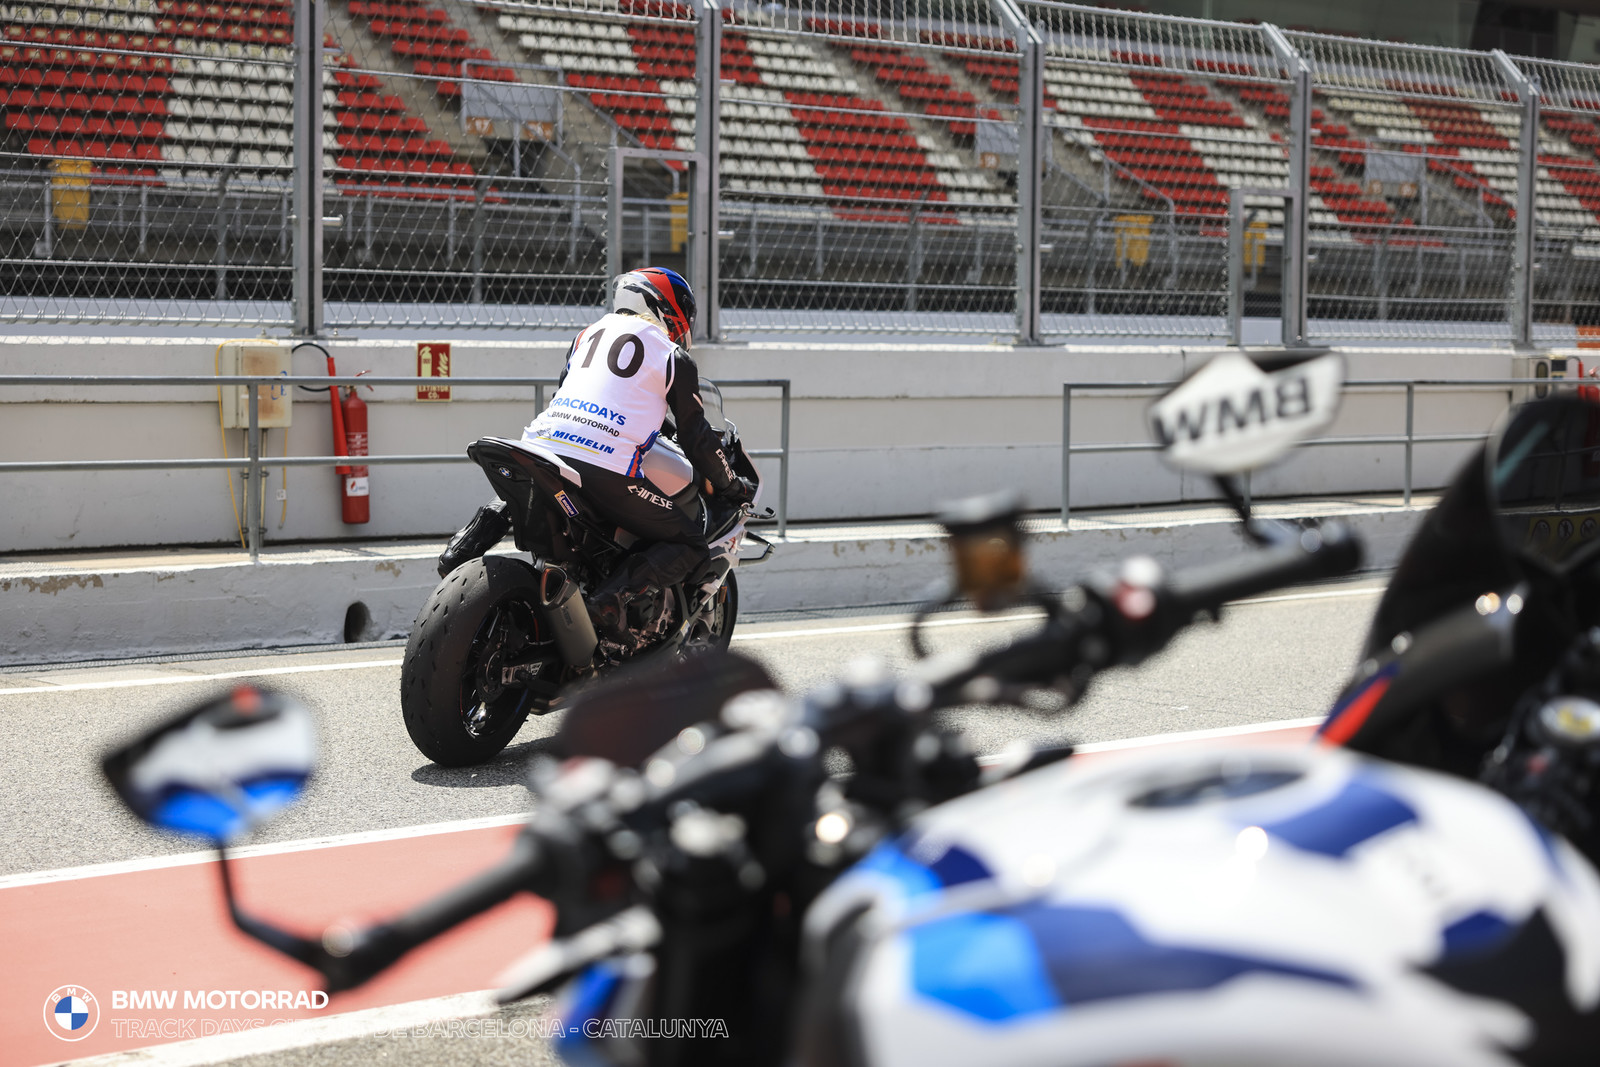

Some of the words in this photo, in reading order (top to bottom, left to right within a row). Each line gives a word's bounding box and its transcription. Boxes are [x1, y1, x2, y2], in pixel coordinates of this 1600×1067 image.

[581, 328, 644, 378] 10
[551, 411, 572, 420] BMW
[572, 415, 620, 437] MOTORRAD
[552, 430, 615, 454] MICHELIN
